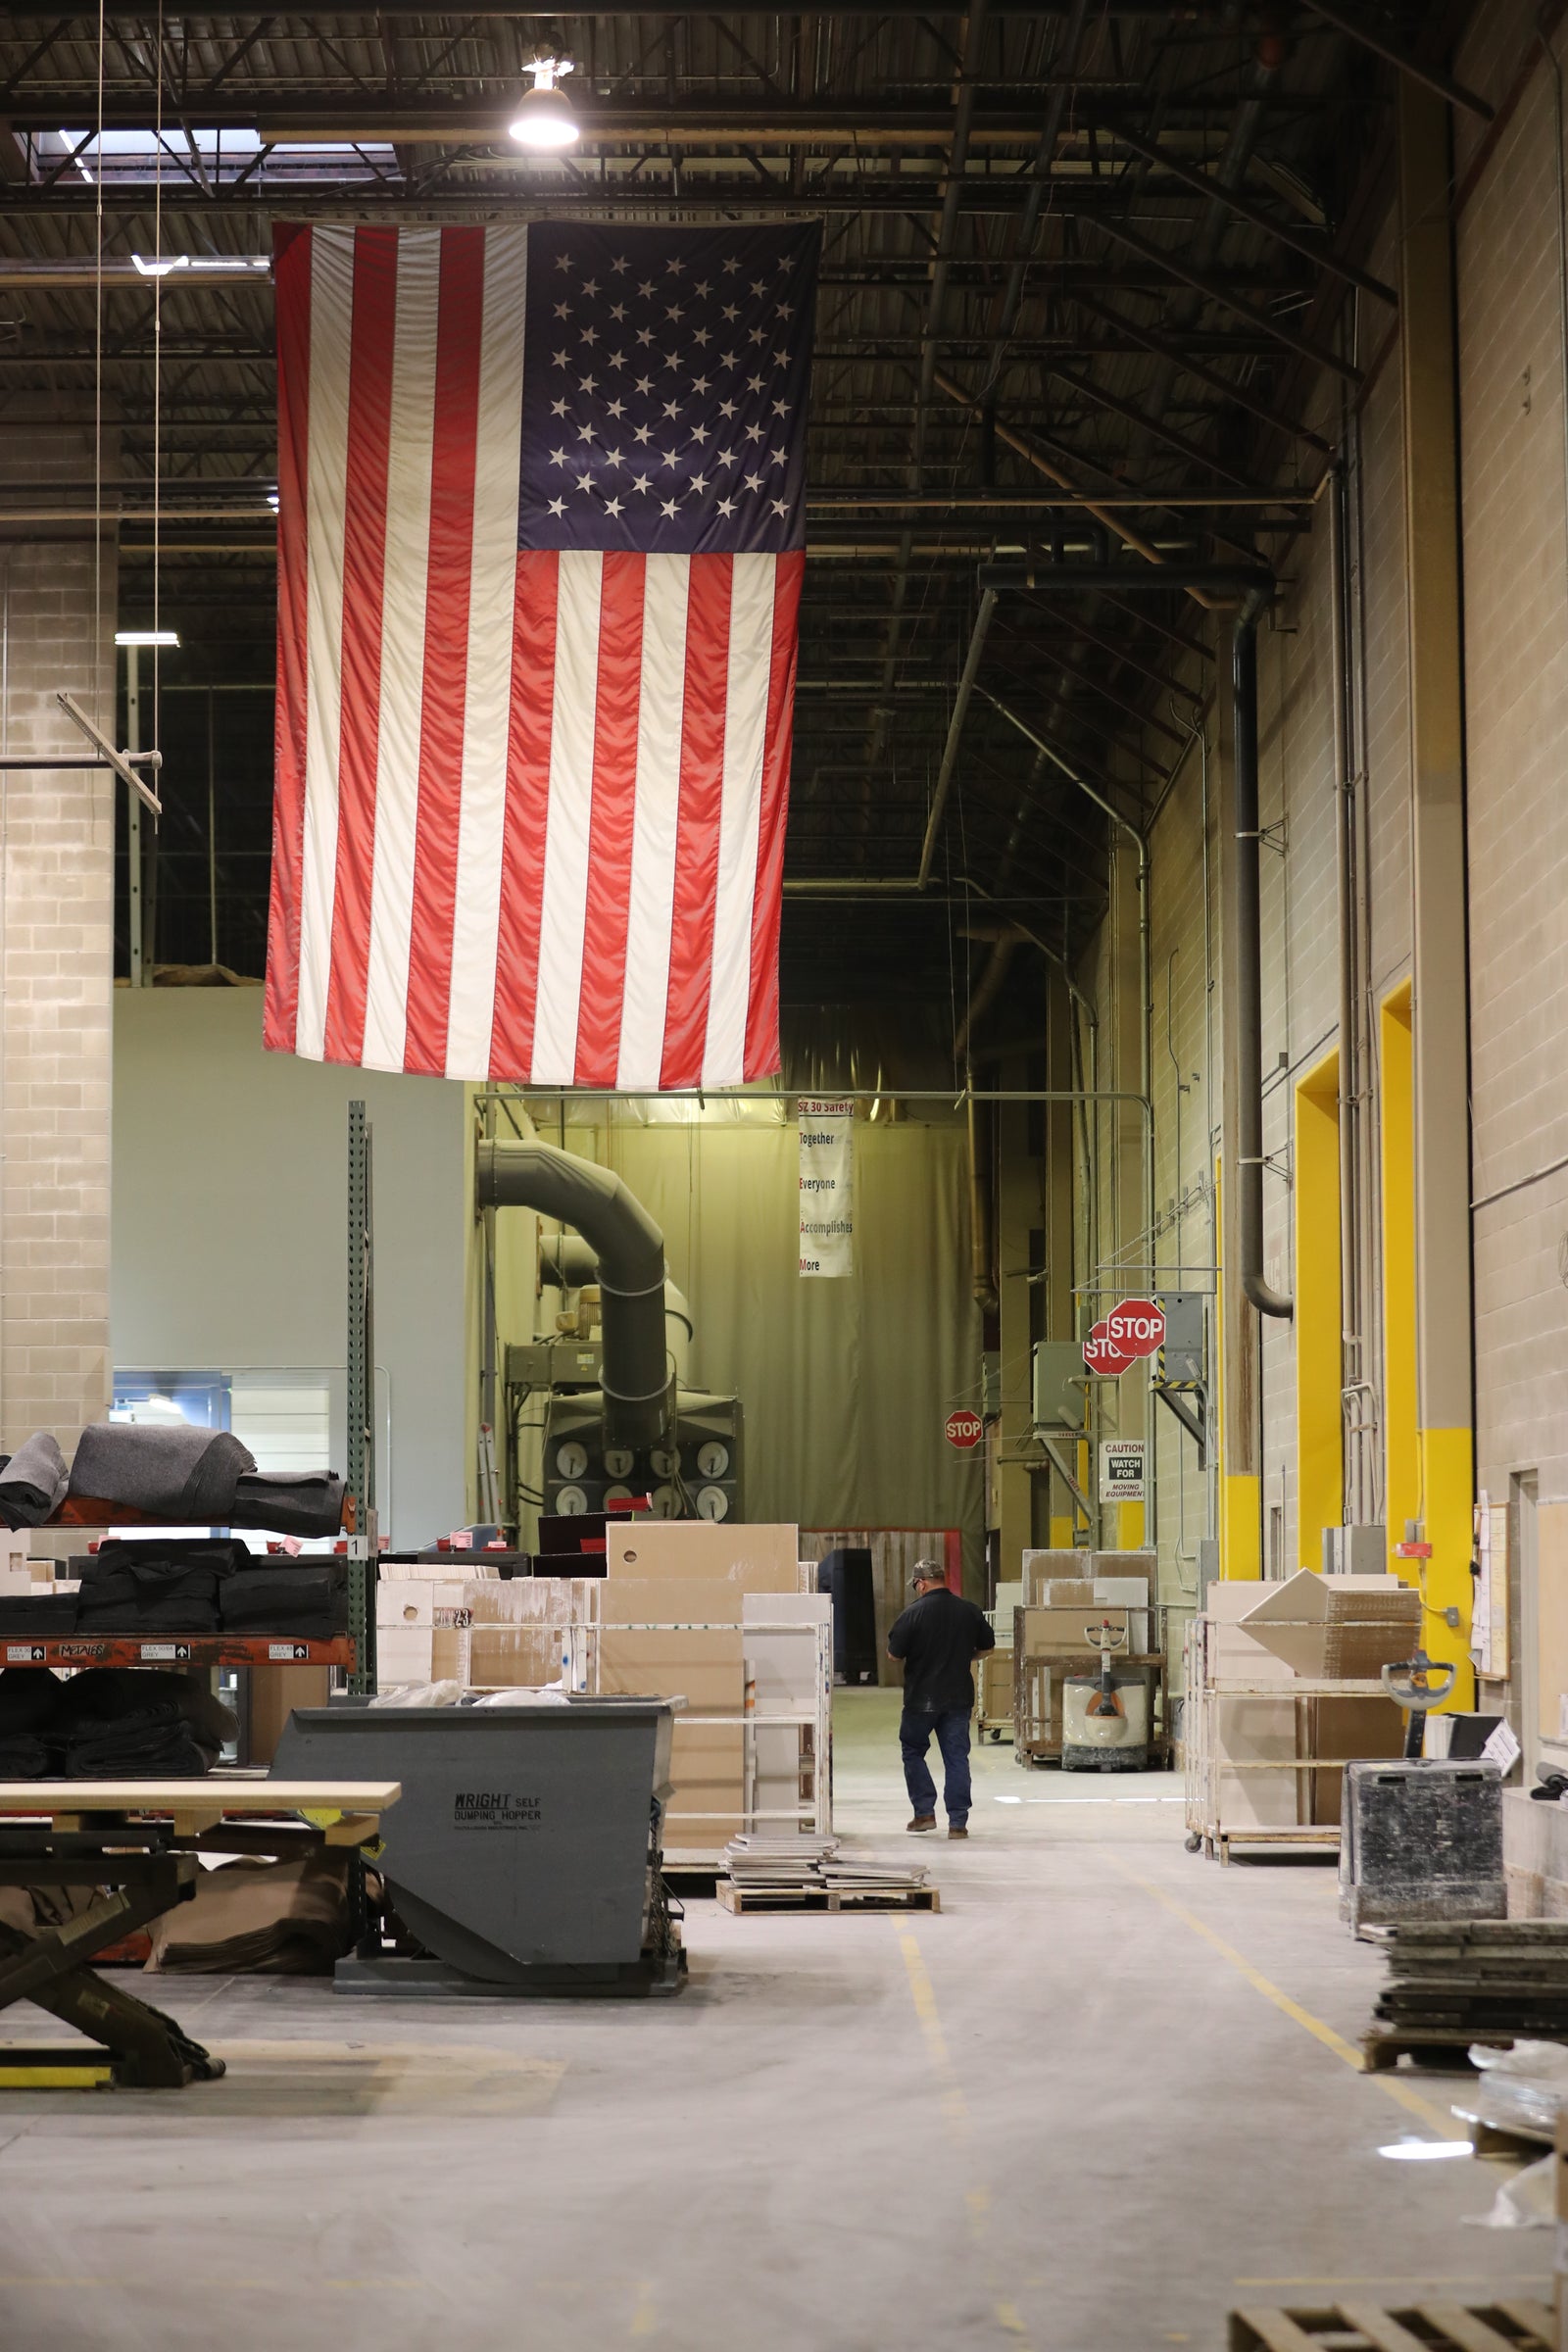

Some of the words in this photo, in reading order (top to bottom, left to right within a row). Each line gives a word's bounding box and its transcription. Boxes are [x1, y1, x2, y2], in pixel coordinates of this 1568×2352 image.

[798, 1102, 808, 1112] SZ
[811, 1102, 822, 1112] 30
[800, 1132, 835, 1148] Together
[800, 1178, 836, 1193] Everyone
[800, 1221, 853, 1237] Accomplishes
[800, 1258, 820, 1271] More
[1110, 1316, 1163, 1340] STOP
[1086, 1338, 1122, 1358] STO
[947, 1421, 981, 1438] STOP
[1105, 1444, 1145, 1453] CAUTION
[1110, 1458, 1141, 1468] WATCH
[1116, 1469, 1135, 1478] FOR
[352, 1539, 358, 1555] 1
[455, 1793, 512, 1808] WRIGHT
[515, 1797, 541, 1808] SELF
[454, 1810, 496, 1821] DUMPING
[501, 1810, 541, 1821] HOPPER
